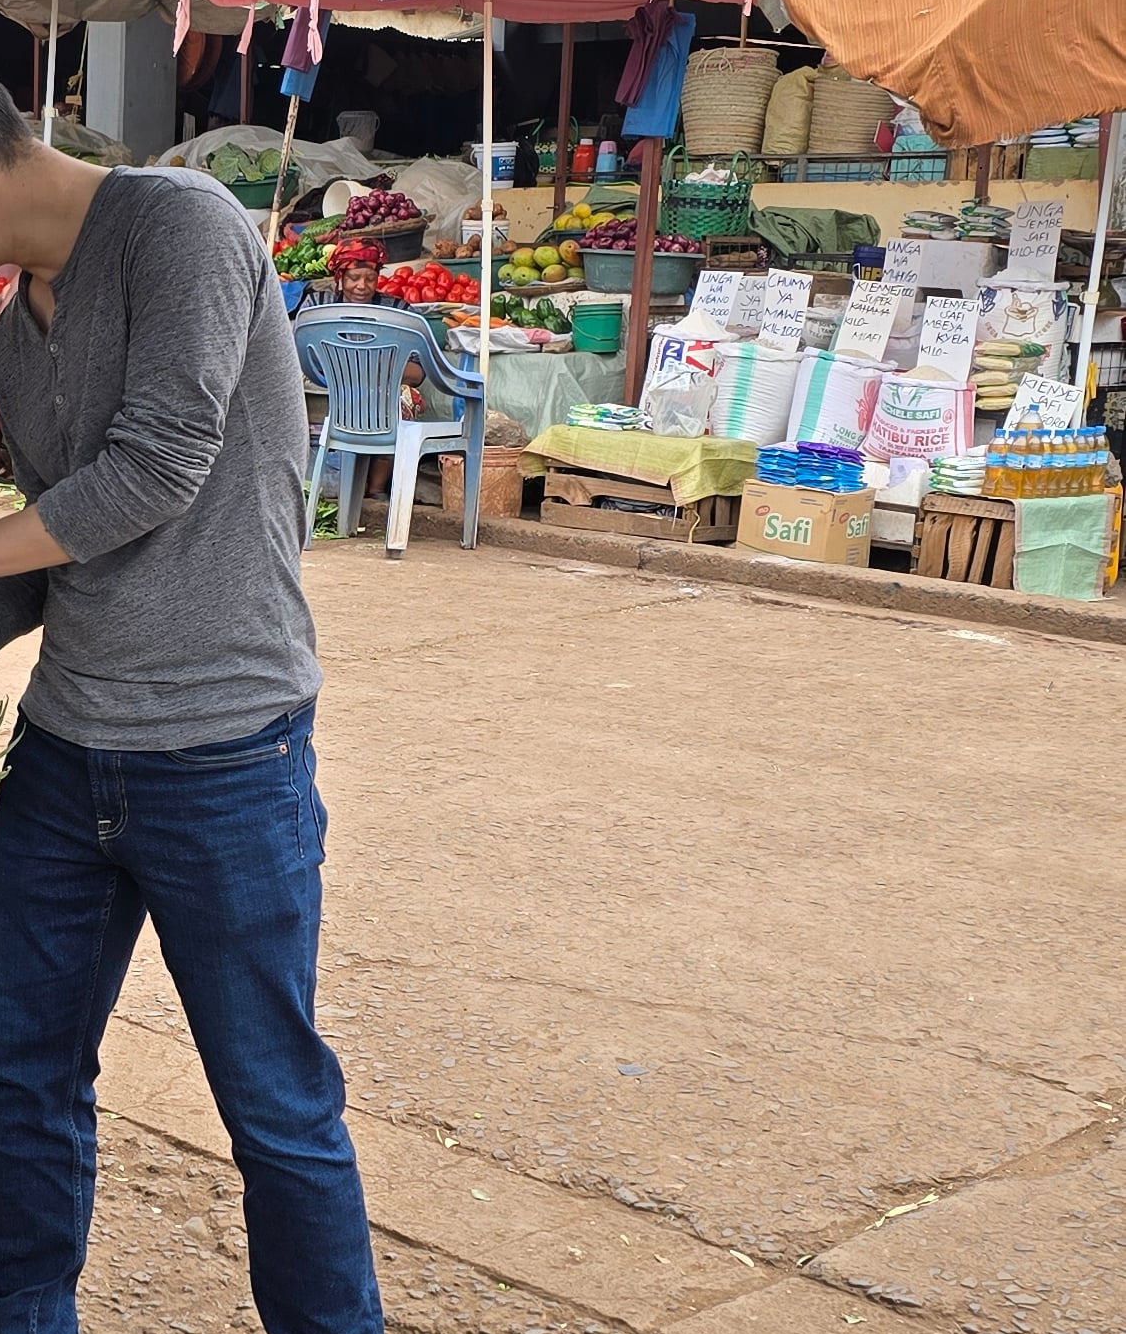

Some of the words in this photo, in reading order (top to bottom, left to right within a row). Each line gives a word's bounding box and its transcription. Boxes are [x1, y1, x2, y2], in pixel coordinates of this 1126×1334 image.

[1016, 203, 1064, 219] UNGA
[1018, 218, 1062, 228] SEMBE
[1023, 232, 1049, 242] SAFI
[887, 241, 921, 255] UNGA
[894, 256, 908, 267] WA
[702, 273, 733, 284] UNGA
[709, 285, 723, 294] WA
[740, 295, 761, 307] YA
[776, 289, 794, 305] YA
[764, 308, 804, 323] MAWE
[923, 319, 963, 333] MBEYA
[935, 332, 969, 345] KYELA
[915, 408, 941, 419] SAFI
[833, 423, 857, 440] LONG
[938, 425, 950, 434] BY
[914, 433, 951, 447] RICE
[764, 514, 811, 544] Safi
